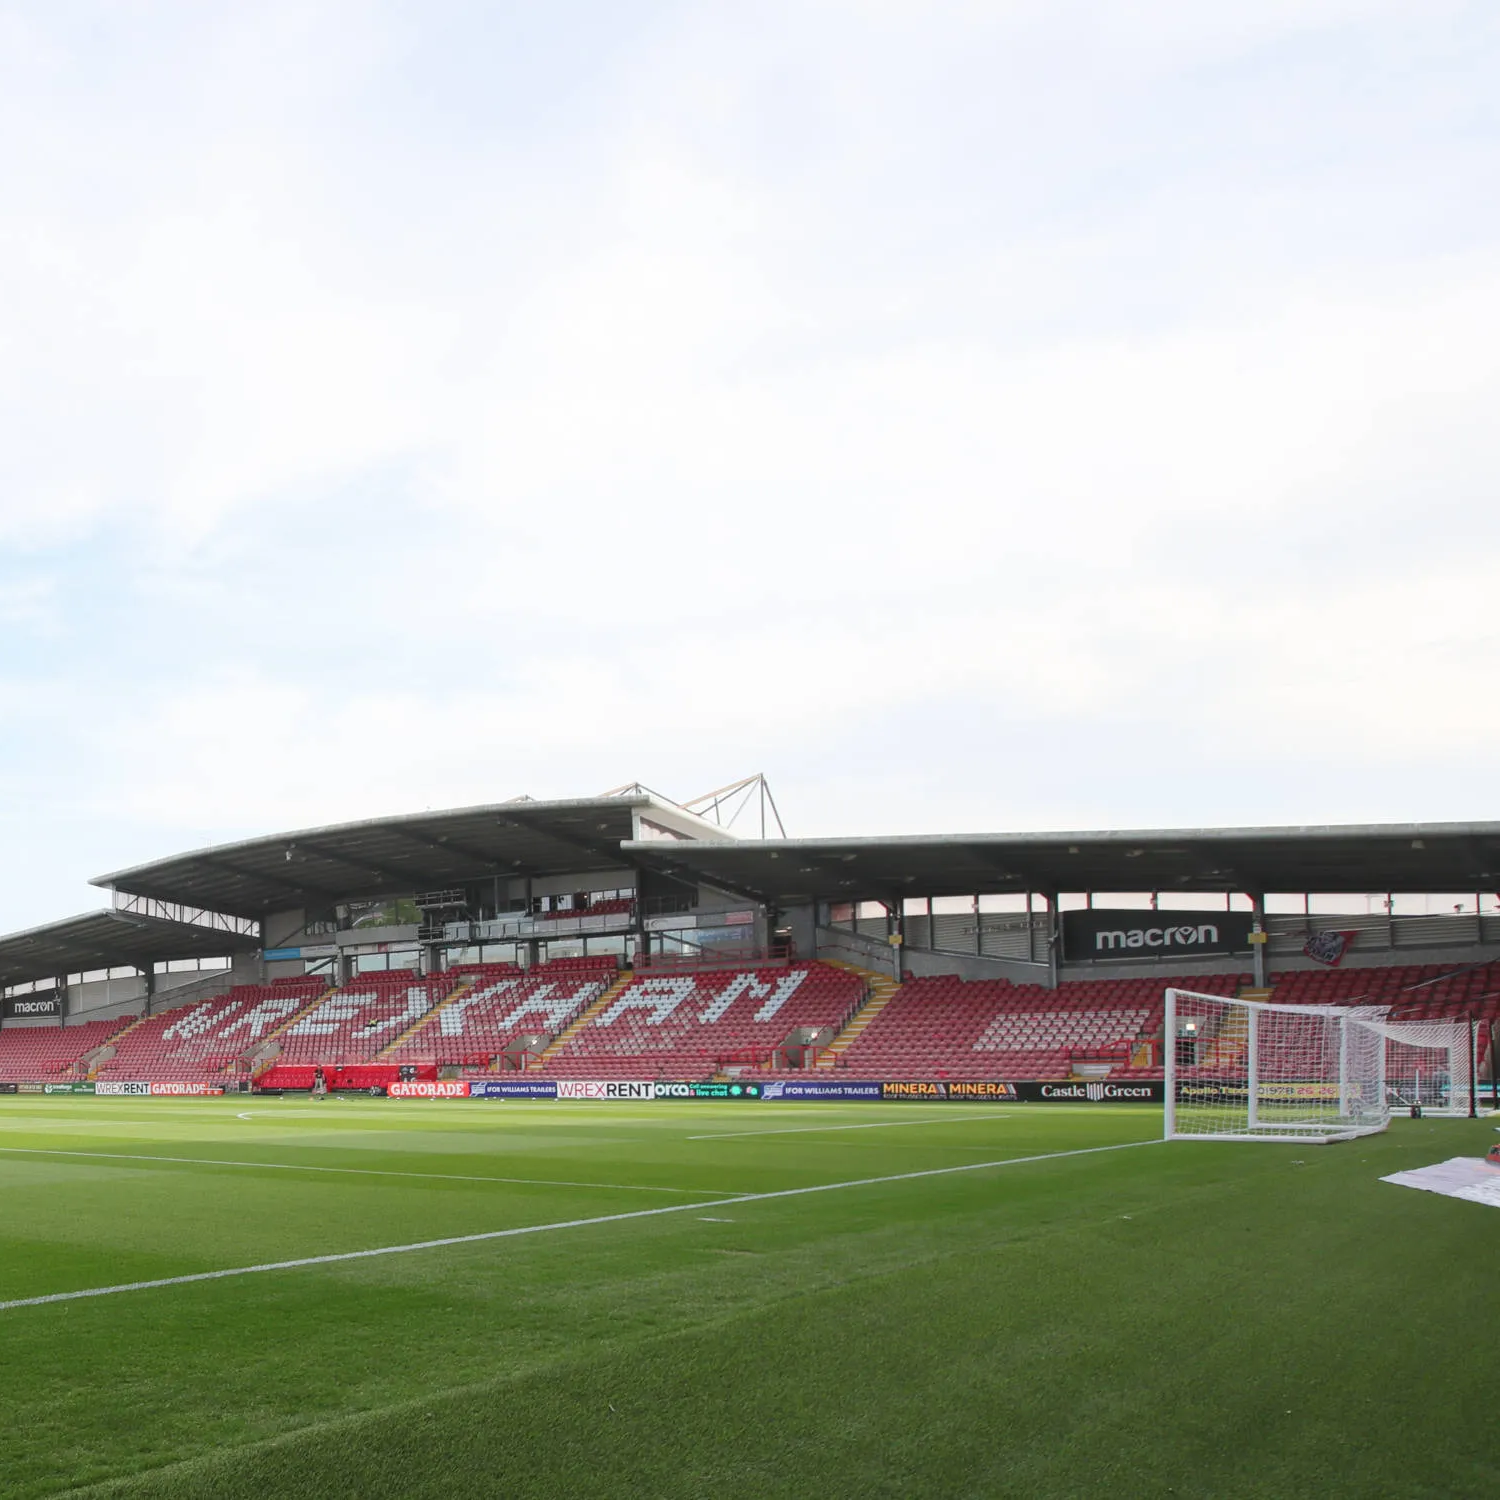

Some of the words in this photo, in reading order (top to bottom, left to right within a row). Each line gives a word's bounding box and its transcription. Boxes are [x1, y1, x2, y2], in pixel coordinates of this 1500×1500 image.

[1096, 924, 1219, 949] macron
[14, 1001, 54, 1013] macron
[163, 970, 808, 1042] WREXHAM
[96, 1083, 149, 1094] WREXRENT
[390, 1084, 464, 1096] GATORADE
[559, 1082, 653, 1098] WREXRENT
[655, 1083, 689, 1096] orca
[883, 1083, 937, 1094] MINERA
[949, 1083, 1007, 1094] MINERA
[1041, 1084, 1085, 1097] Castle
[1105, 1085, 1151, 1097] Green
